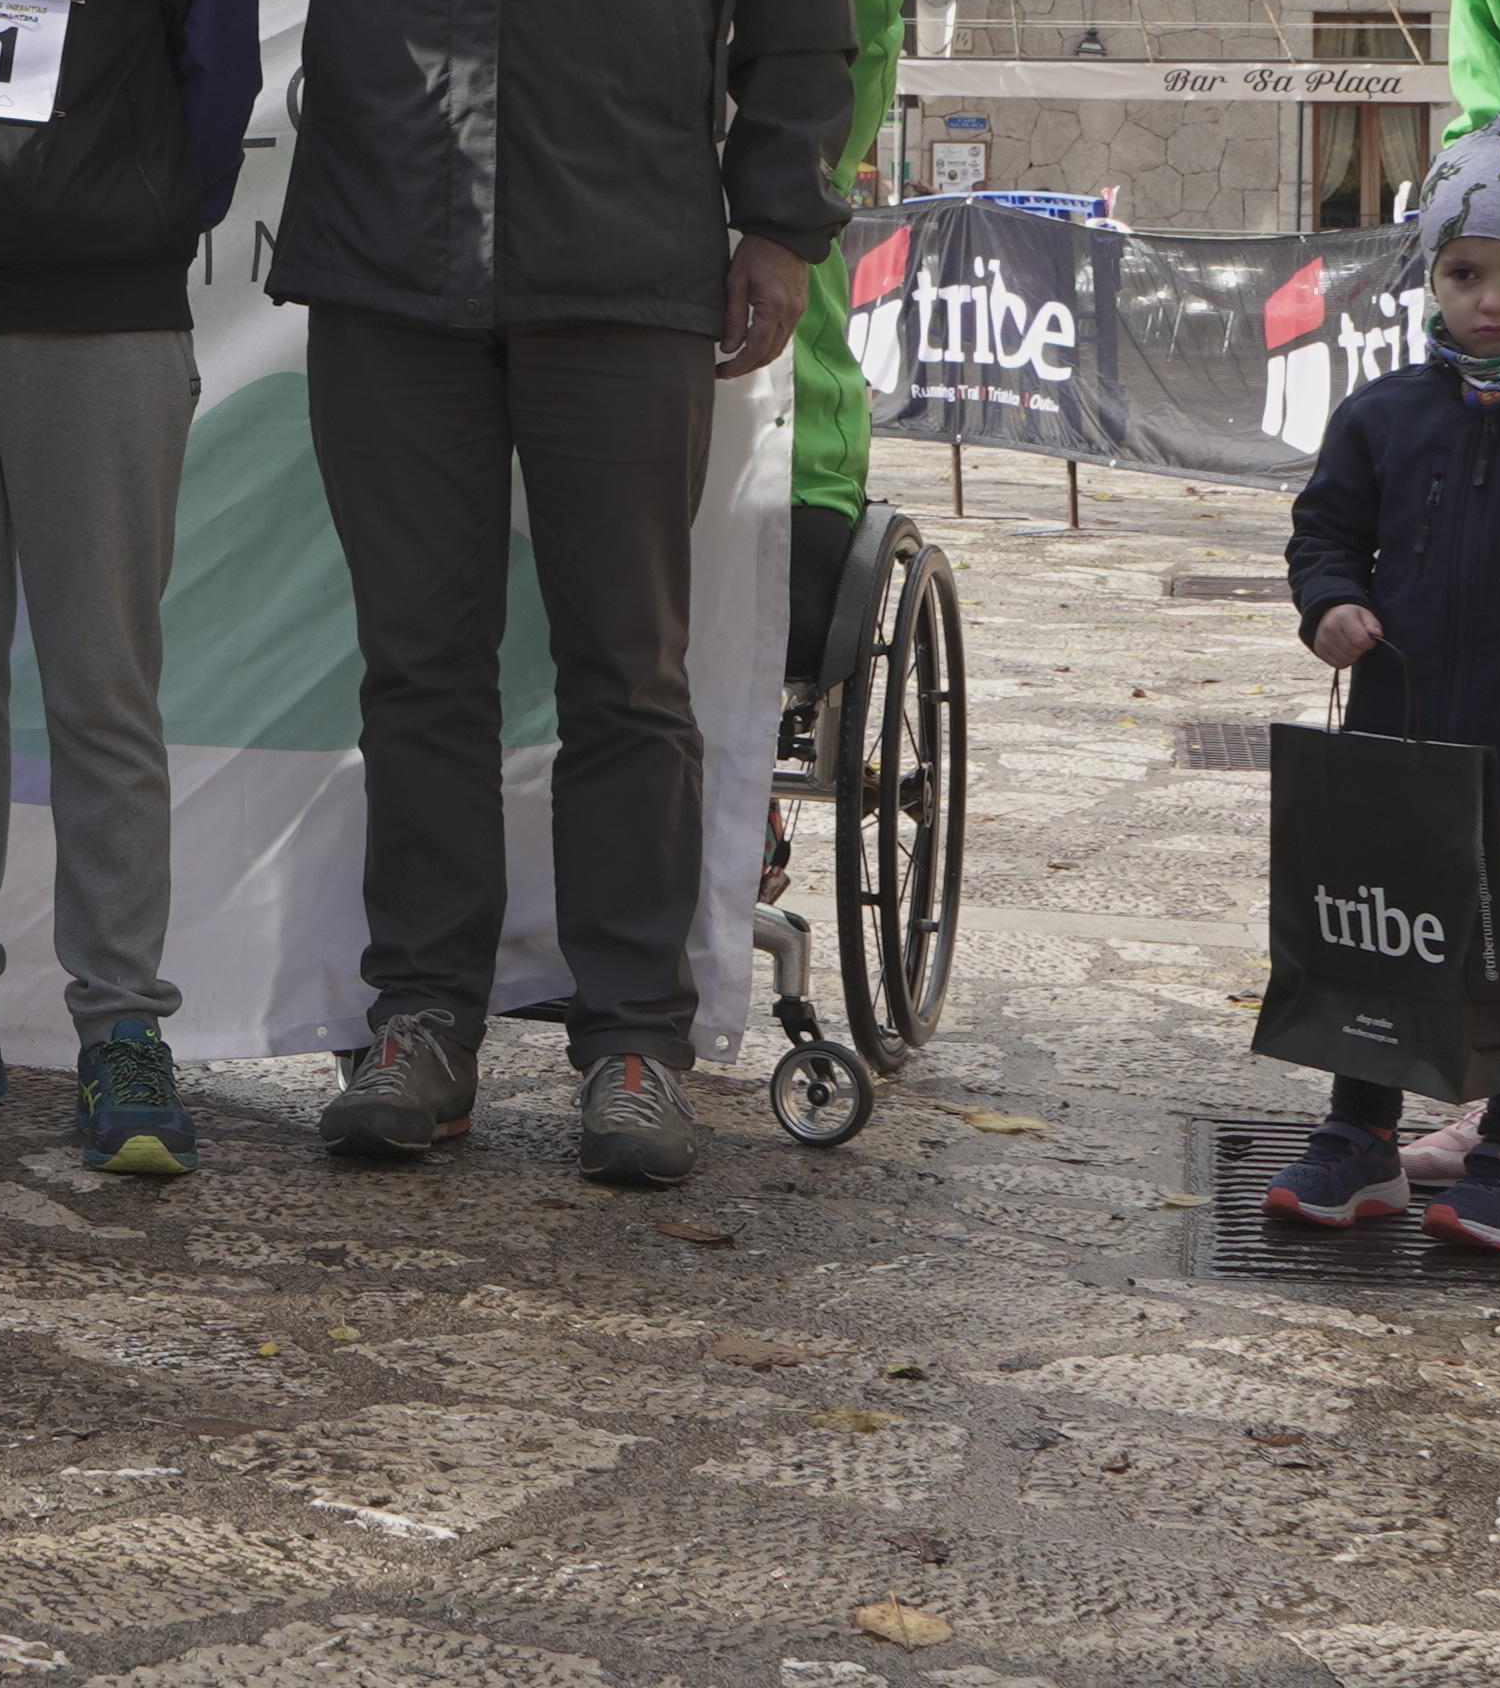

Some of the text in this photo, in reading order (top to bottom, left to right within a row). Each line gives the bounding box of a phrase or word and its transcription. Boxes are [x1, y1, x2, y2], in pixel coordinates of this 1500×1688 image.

[1164, 68, 1403, 99] Bar Sa Plaça
[911, 256, 1076, 381] tribe
[910, 384, 956, 403] Running
[1314, 884, 1446, 964] tribe
